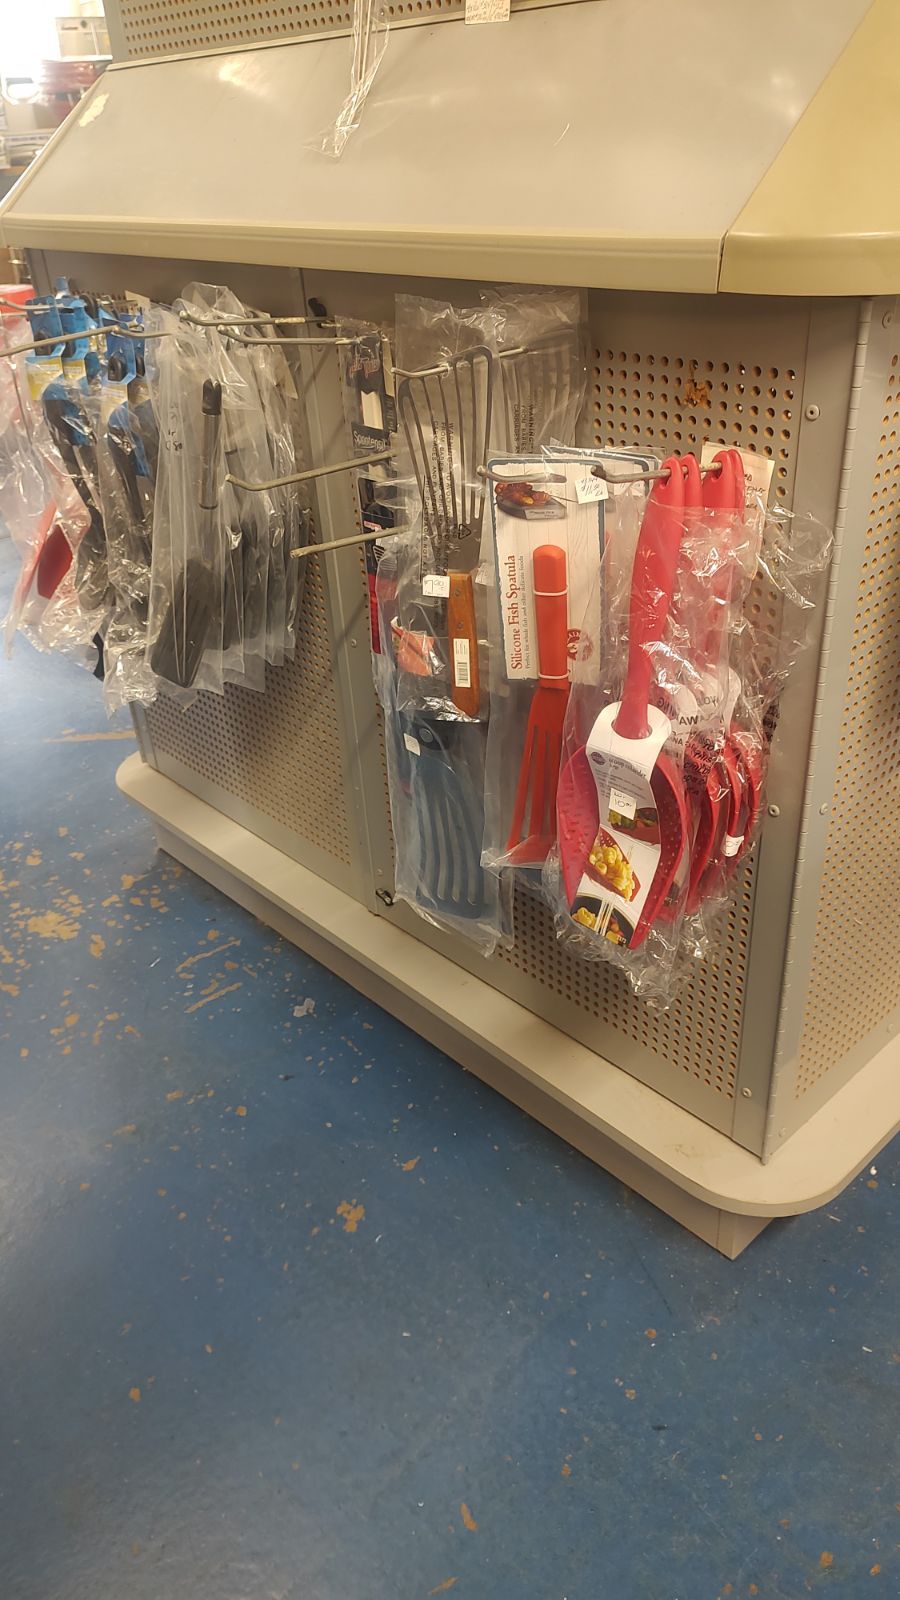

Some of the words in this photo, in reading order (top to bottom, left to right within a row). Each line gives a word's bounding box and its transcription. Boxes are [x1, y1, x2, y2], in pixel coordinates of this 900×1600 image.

[504, 555, 521, 599] Spatula
[507, 602, 520, 626] Fish
[511, 628, 523, 670] Silicone
